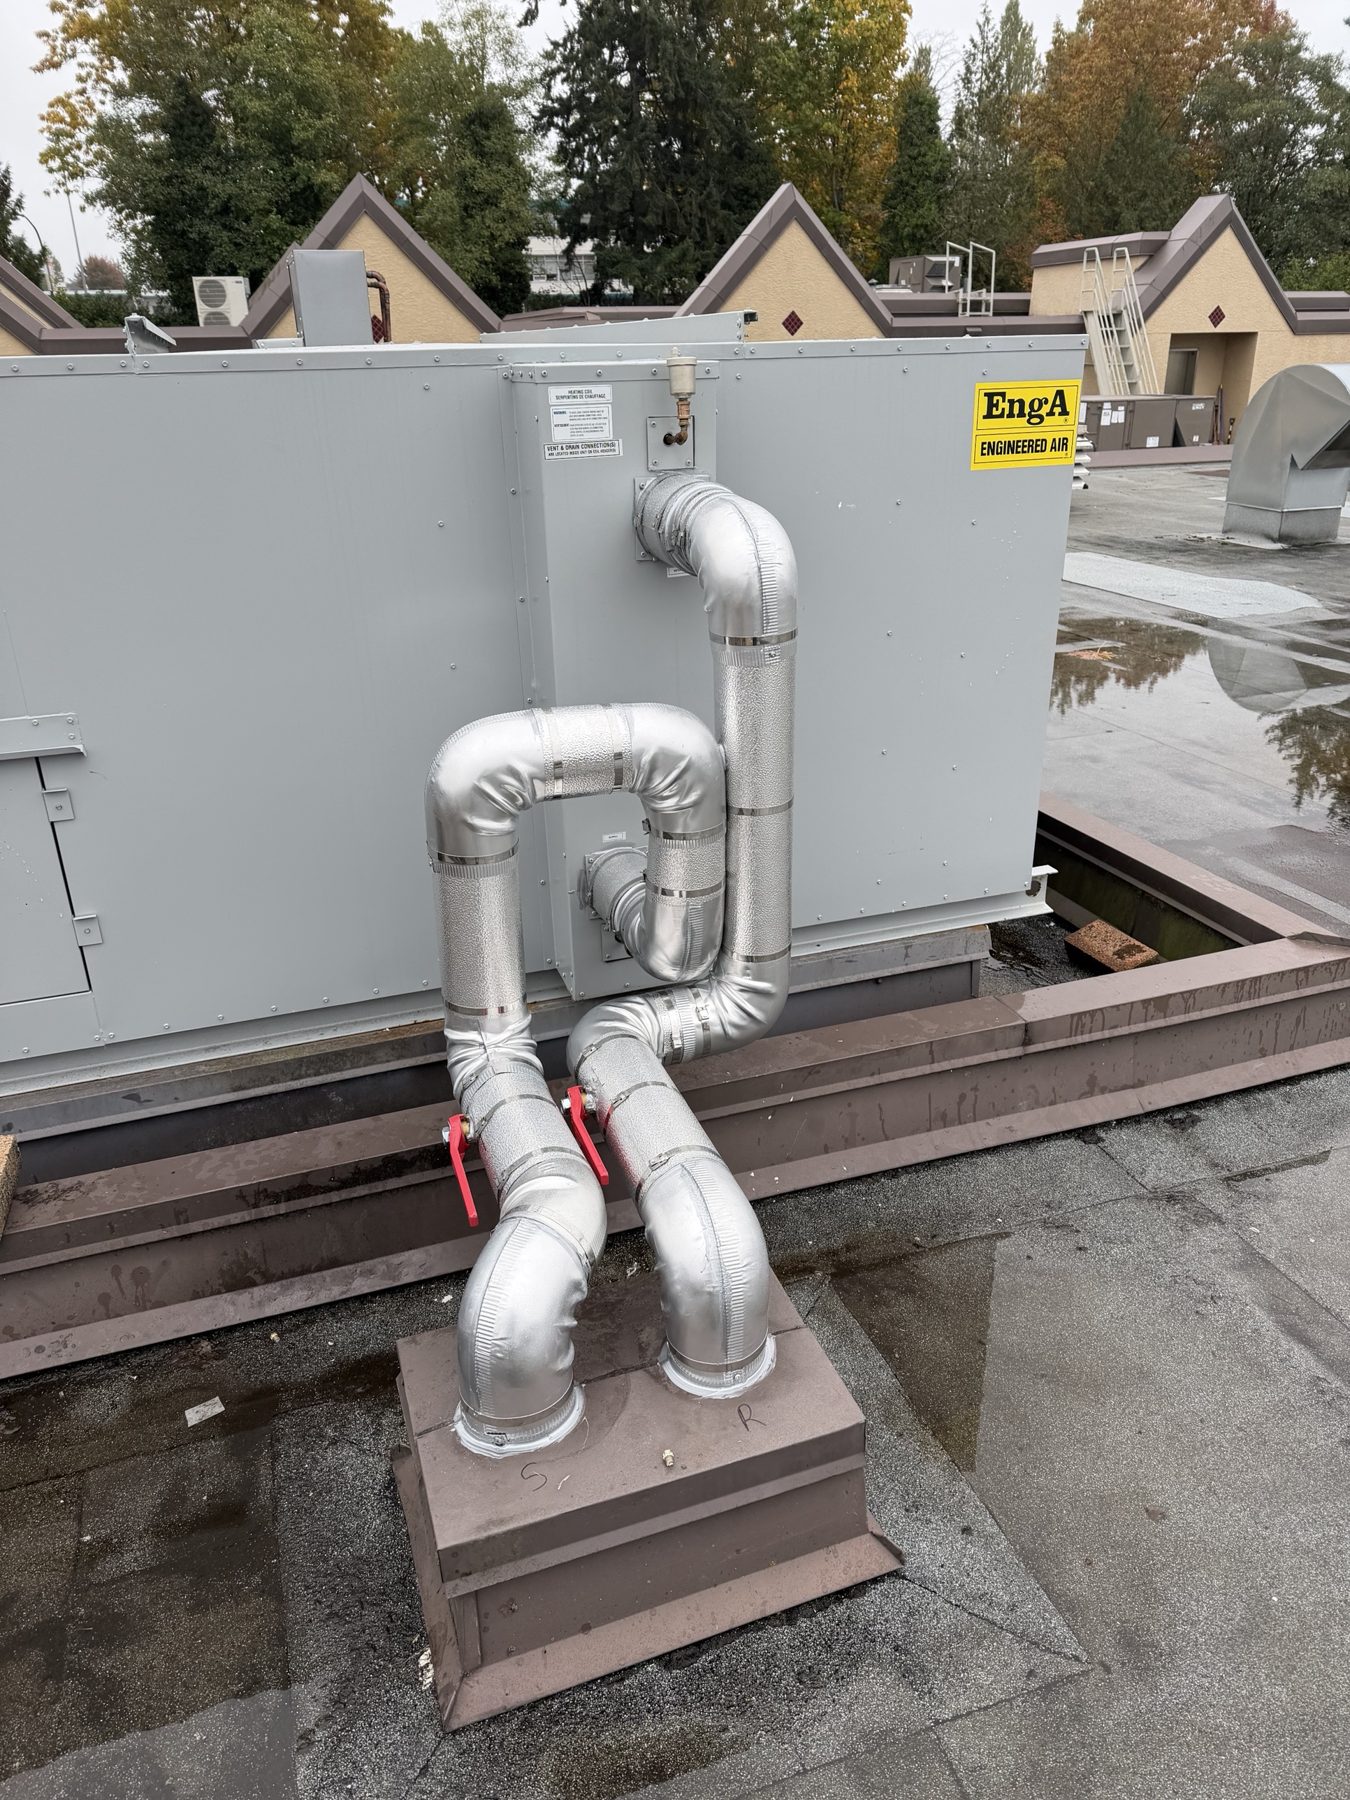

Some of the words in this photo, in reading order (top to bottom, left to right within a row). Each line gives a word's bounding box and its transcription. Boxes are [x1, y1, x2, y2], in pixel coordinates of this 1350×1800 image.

[983, 389, 1069, 425] EngA
[980, 438, 1047, 456] ENGINEERED
[1050, 437, 1068, 452] AIR
[736, 1402, 767, 1432] R
[520, 1462, 548, 1492] S
